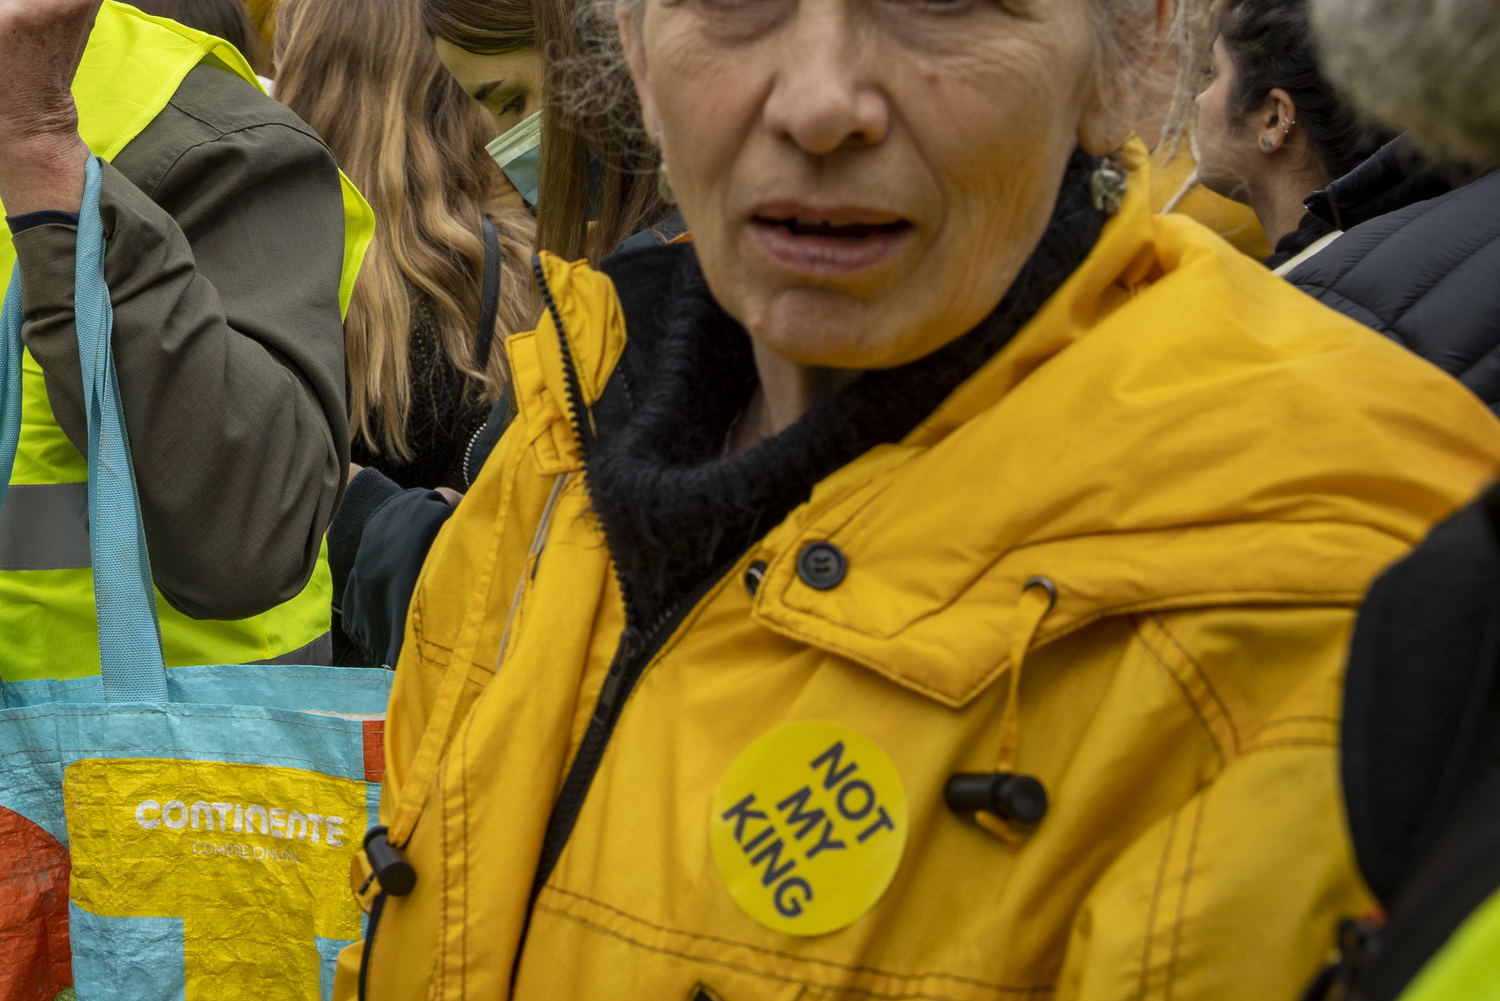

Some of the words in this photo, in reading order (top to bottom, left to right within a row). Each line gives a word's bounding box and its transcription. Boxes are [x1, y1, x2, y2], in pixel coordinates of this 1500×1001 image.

[776, 786, 848, 860] MY
[809, 740, 895, 844] NOT
[192, 841, 250, 860] COMPRE
[721, 793, 815, 919] KING
